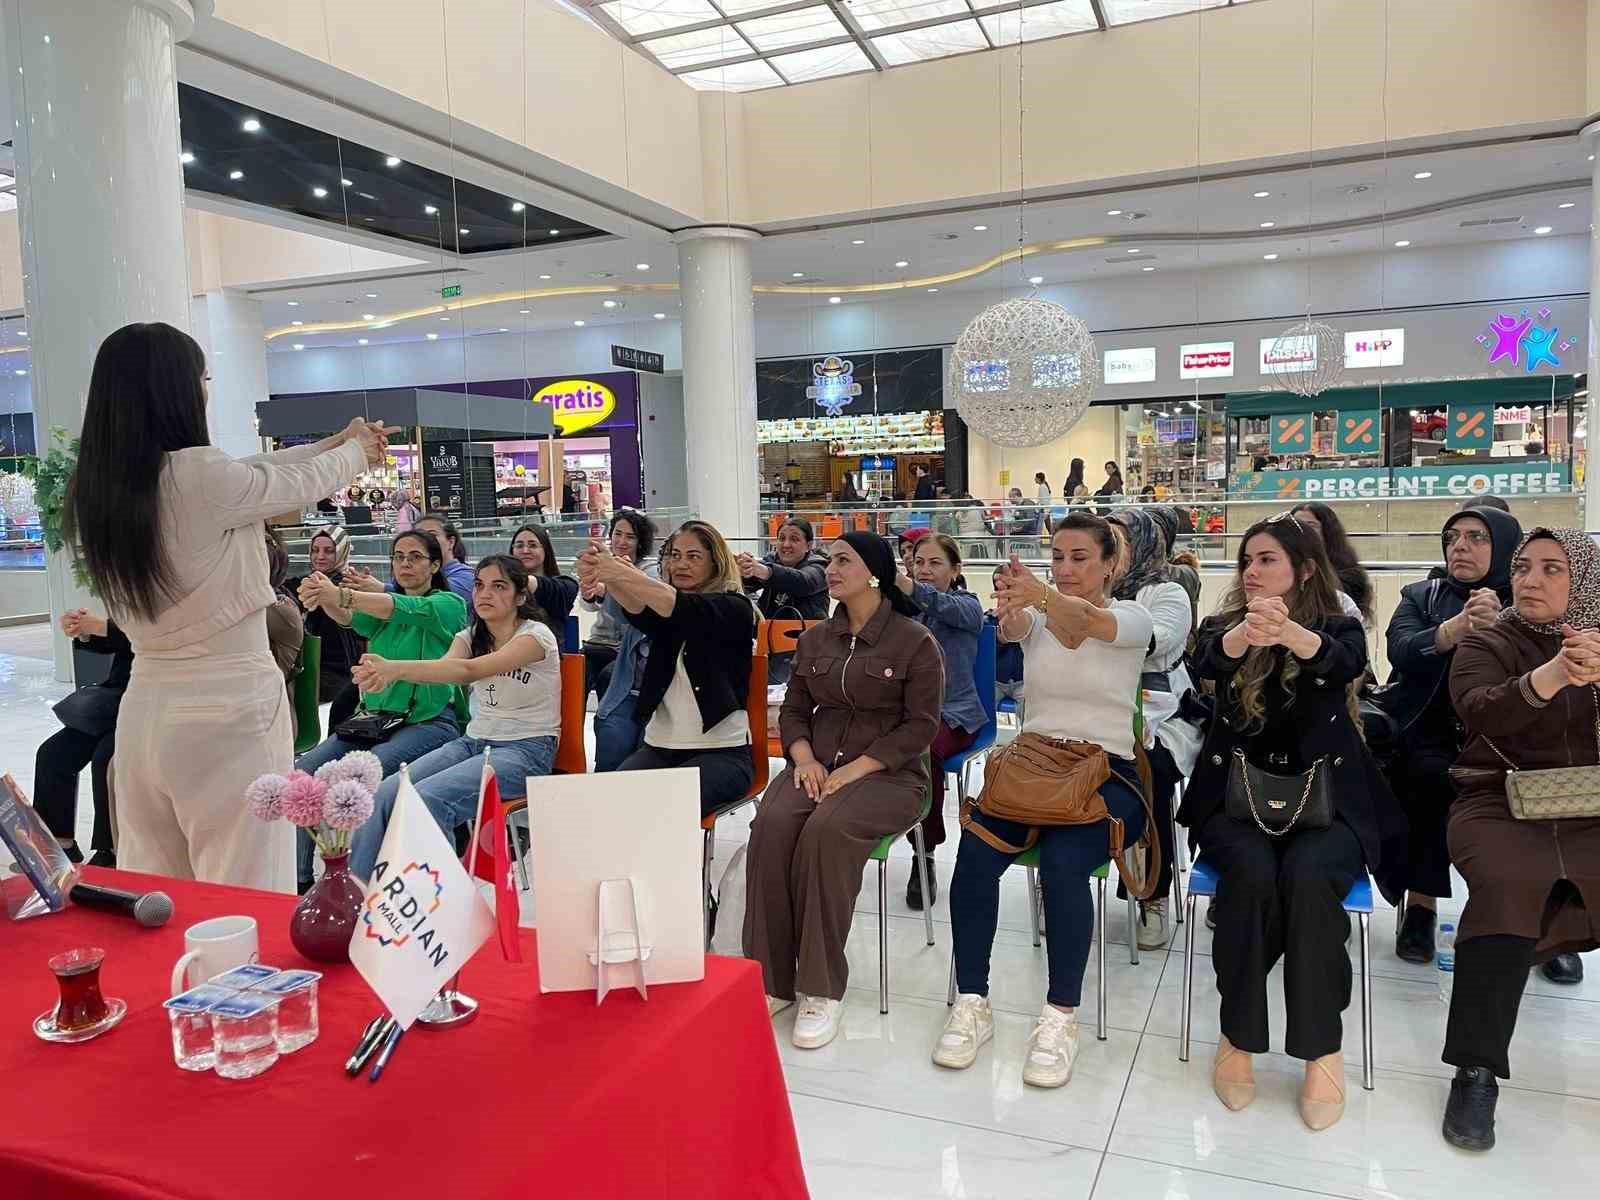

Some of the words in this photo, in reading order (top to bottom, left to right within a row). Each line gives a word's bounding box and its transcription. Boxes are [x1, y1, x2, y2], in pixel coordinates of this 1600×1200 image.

[430, 455, 458, 469] YAKUB
[1305, 475, 1440, 499] PERCENT
[1447, 473, 1561, 496] COFFEE
[372, 861, 449, 968] ARDIAN
[378, 902, 404, 935] MALL
